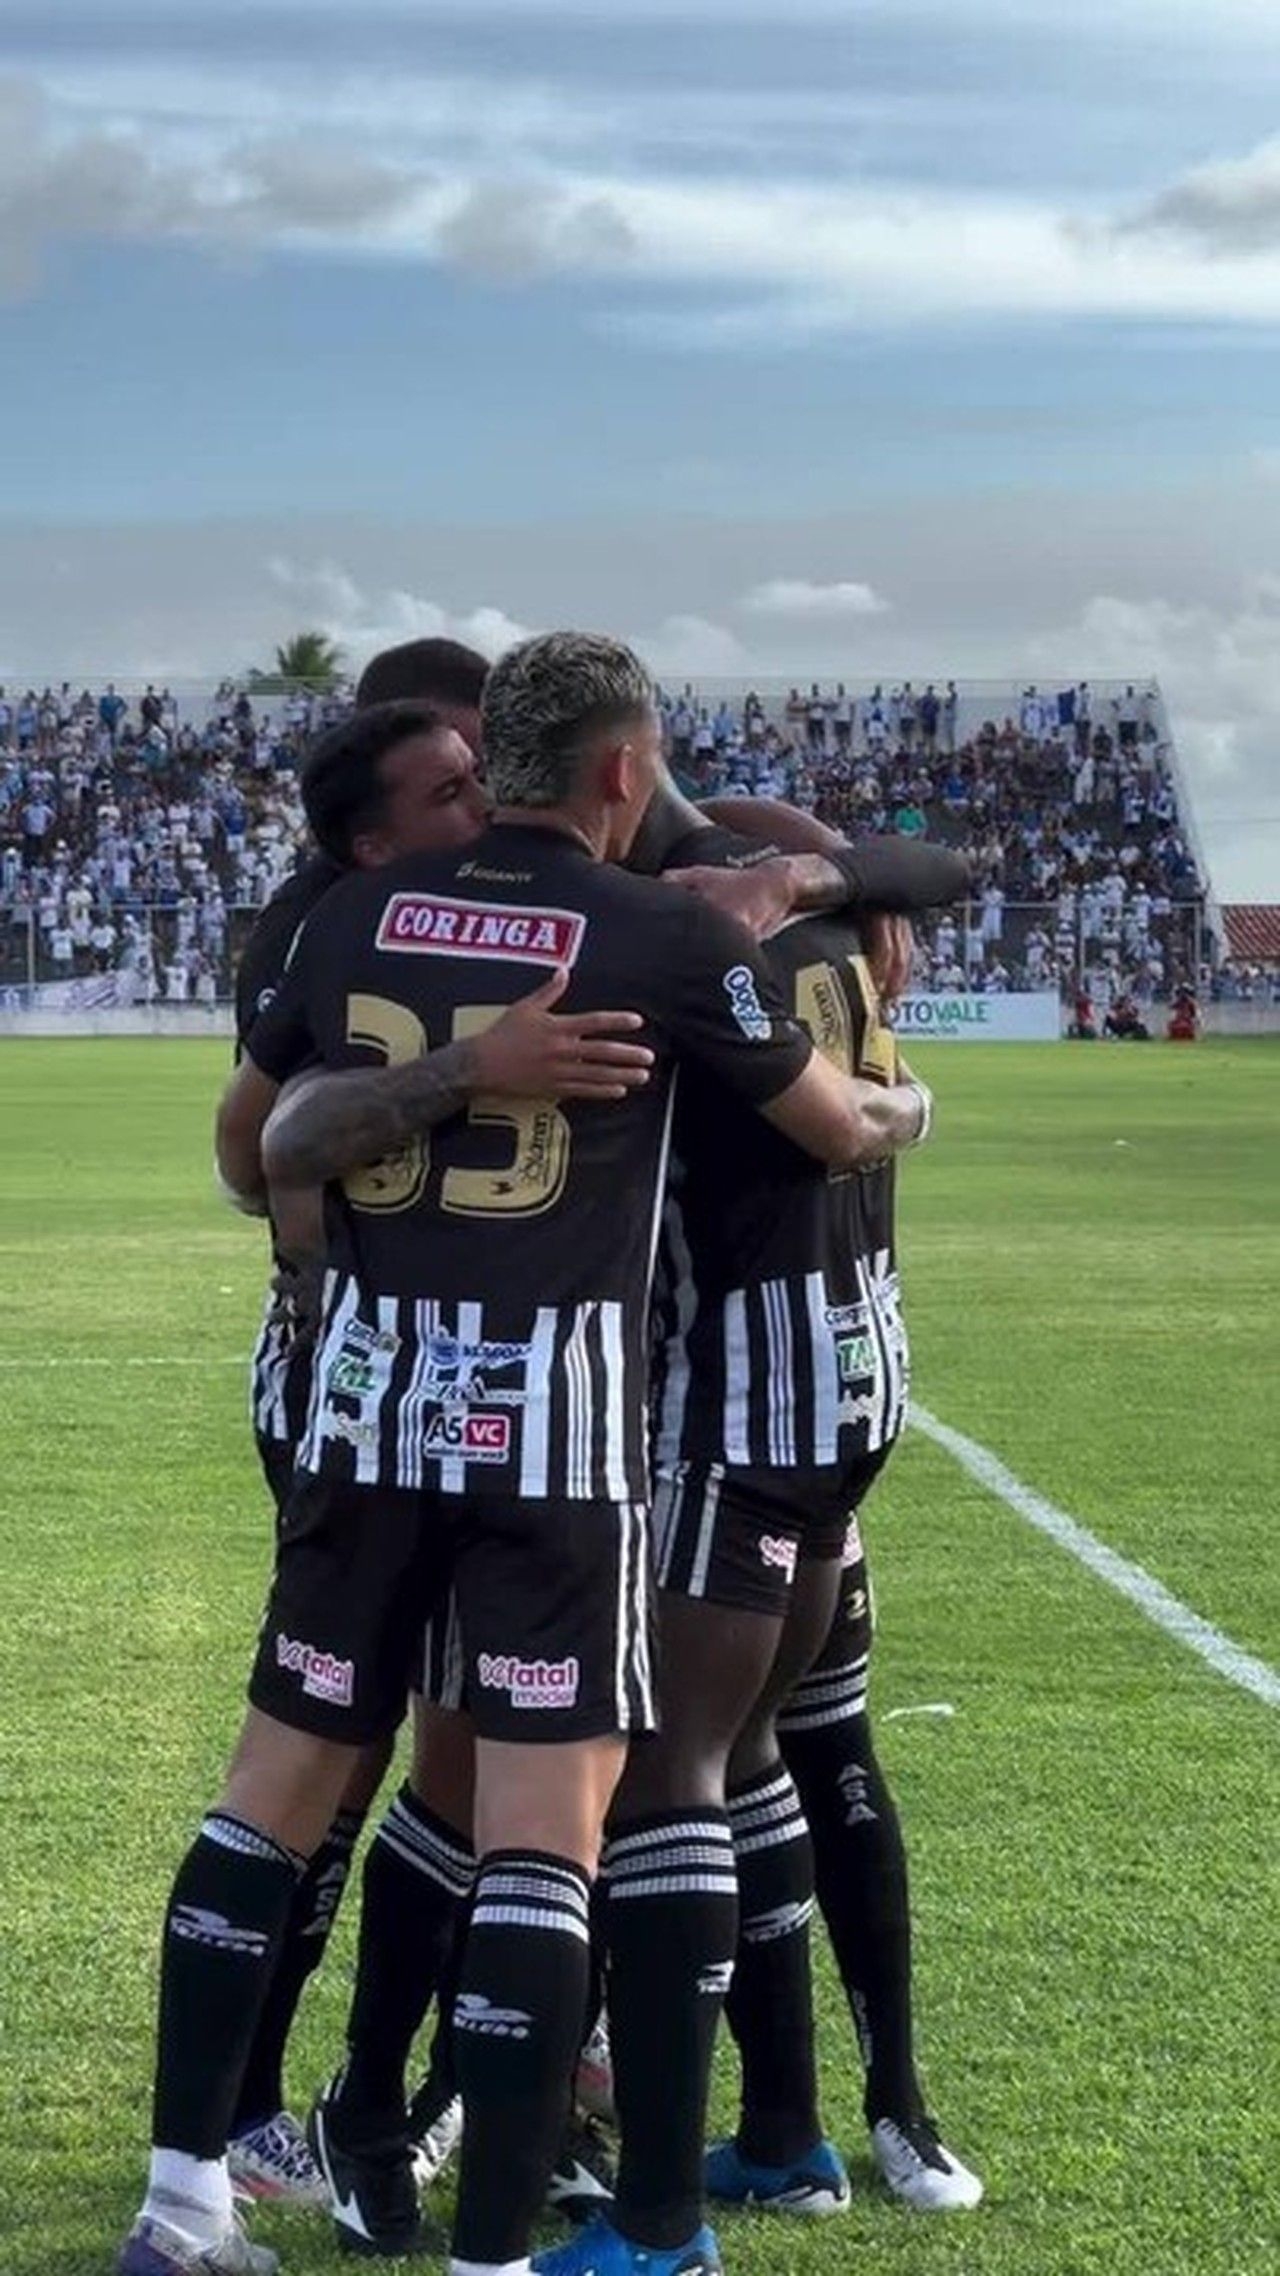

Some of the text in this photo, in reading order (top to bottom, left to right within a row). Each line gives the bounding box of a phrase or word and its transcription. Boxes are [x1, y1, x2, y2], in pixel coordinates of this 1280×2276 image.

[394, 905, 558, 951] CORINGA
[886, 1000, 989, 1025] OTOVALE
[507, 1661, 575, 1685] fatal
[838, 1763, 878, 1826] ASA
